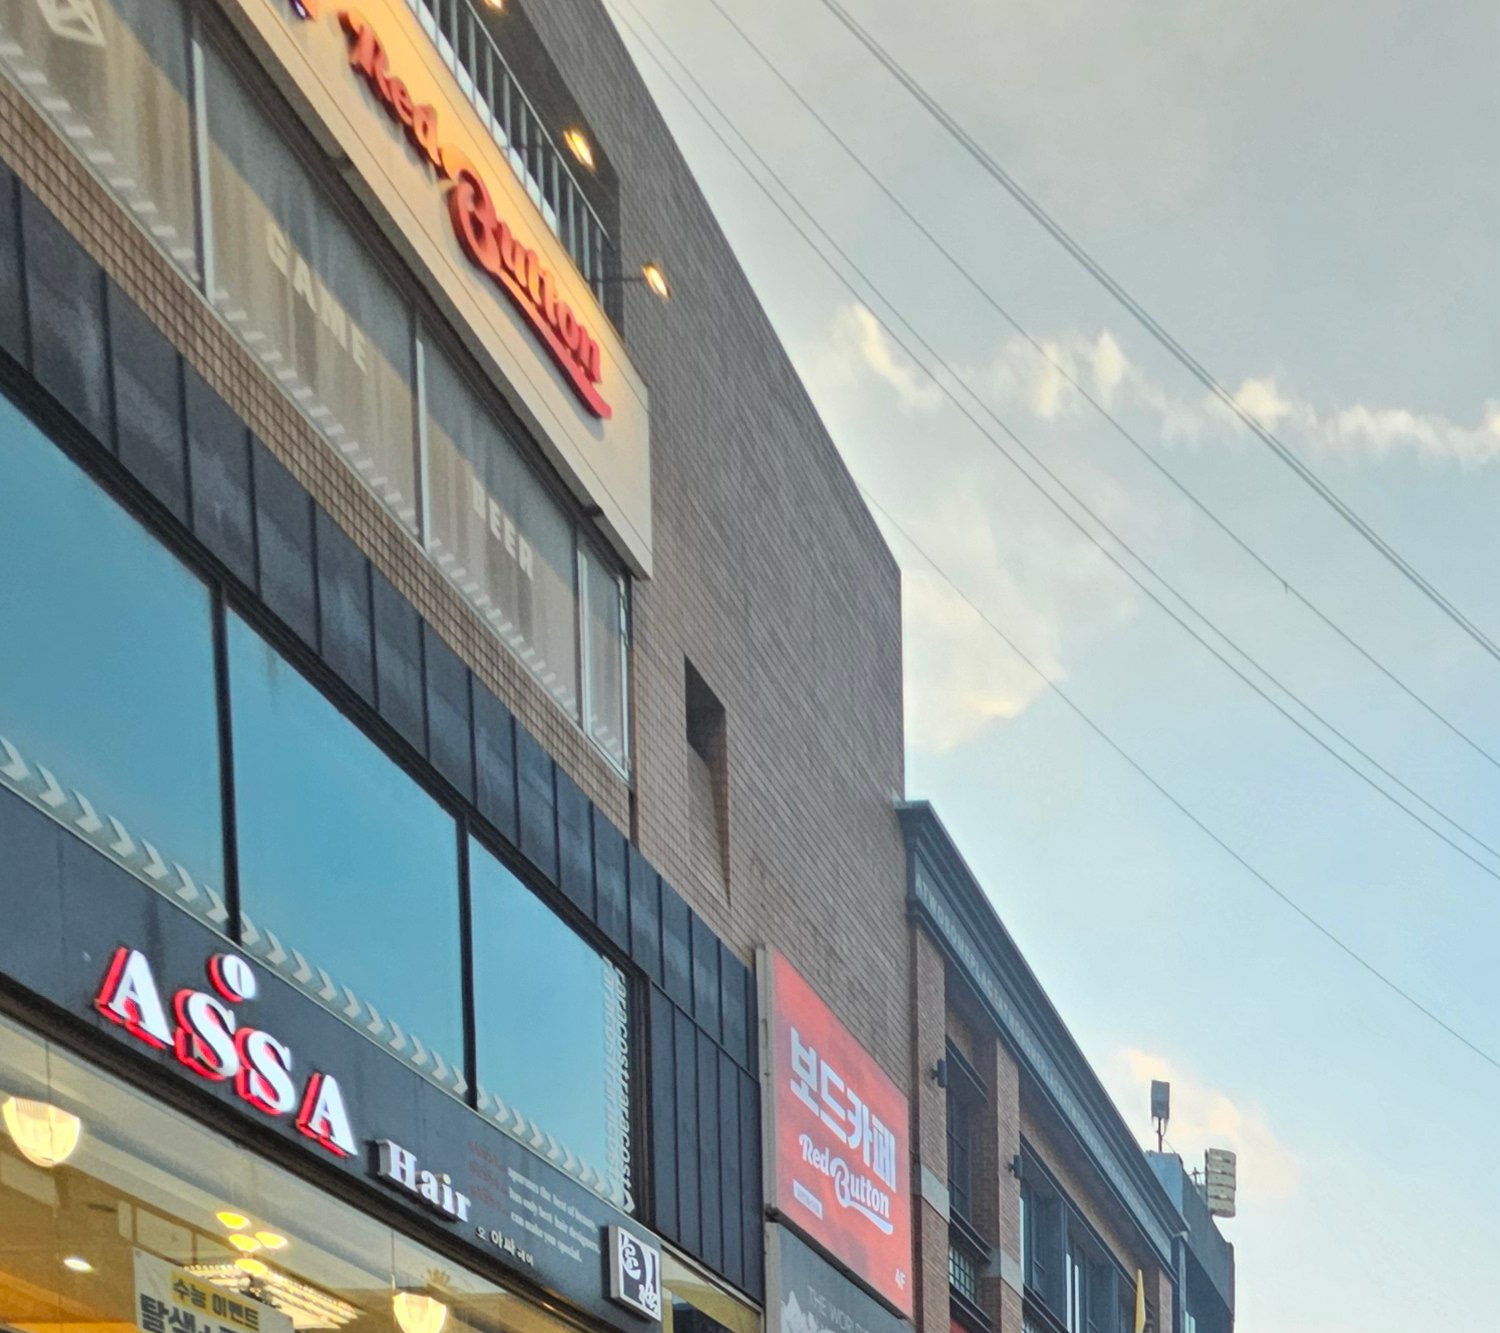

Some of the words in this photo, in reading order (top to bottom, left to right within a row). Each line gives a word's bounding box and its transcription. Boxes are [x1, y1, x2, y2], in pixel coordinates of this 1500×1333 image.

[447, 164, 612, 420] Button
[473, 478, 535, 579] BEER
[96, 946, 358, 1158] ASSA
[377, 1138, 471, 1222] Hair
[790, 1026, 896, 1192] 보드카페
[799, 1134, 833, 1178] Red
[830, 1157, 893, 1235] Button
[172, 1278, 206, 1309] 수능
[212, 1293, 259, 1331] 이벤트
